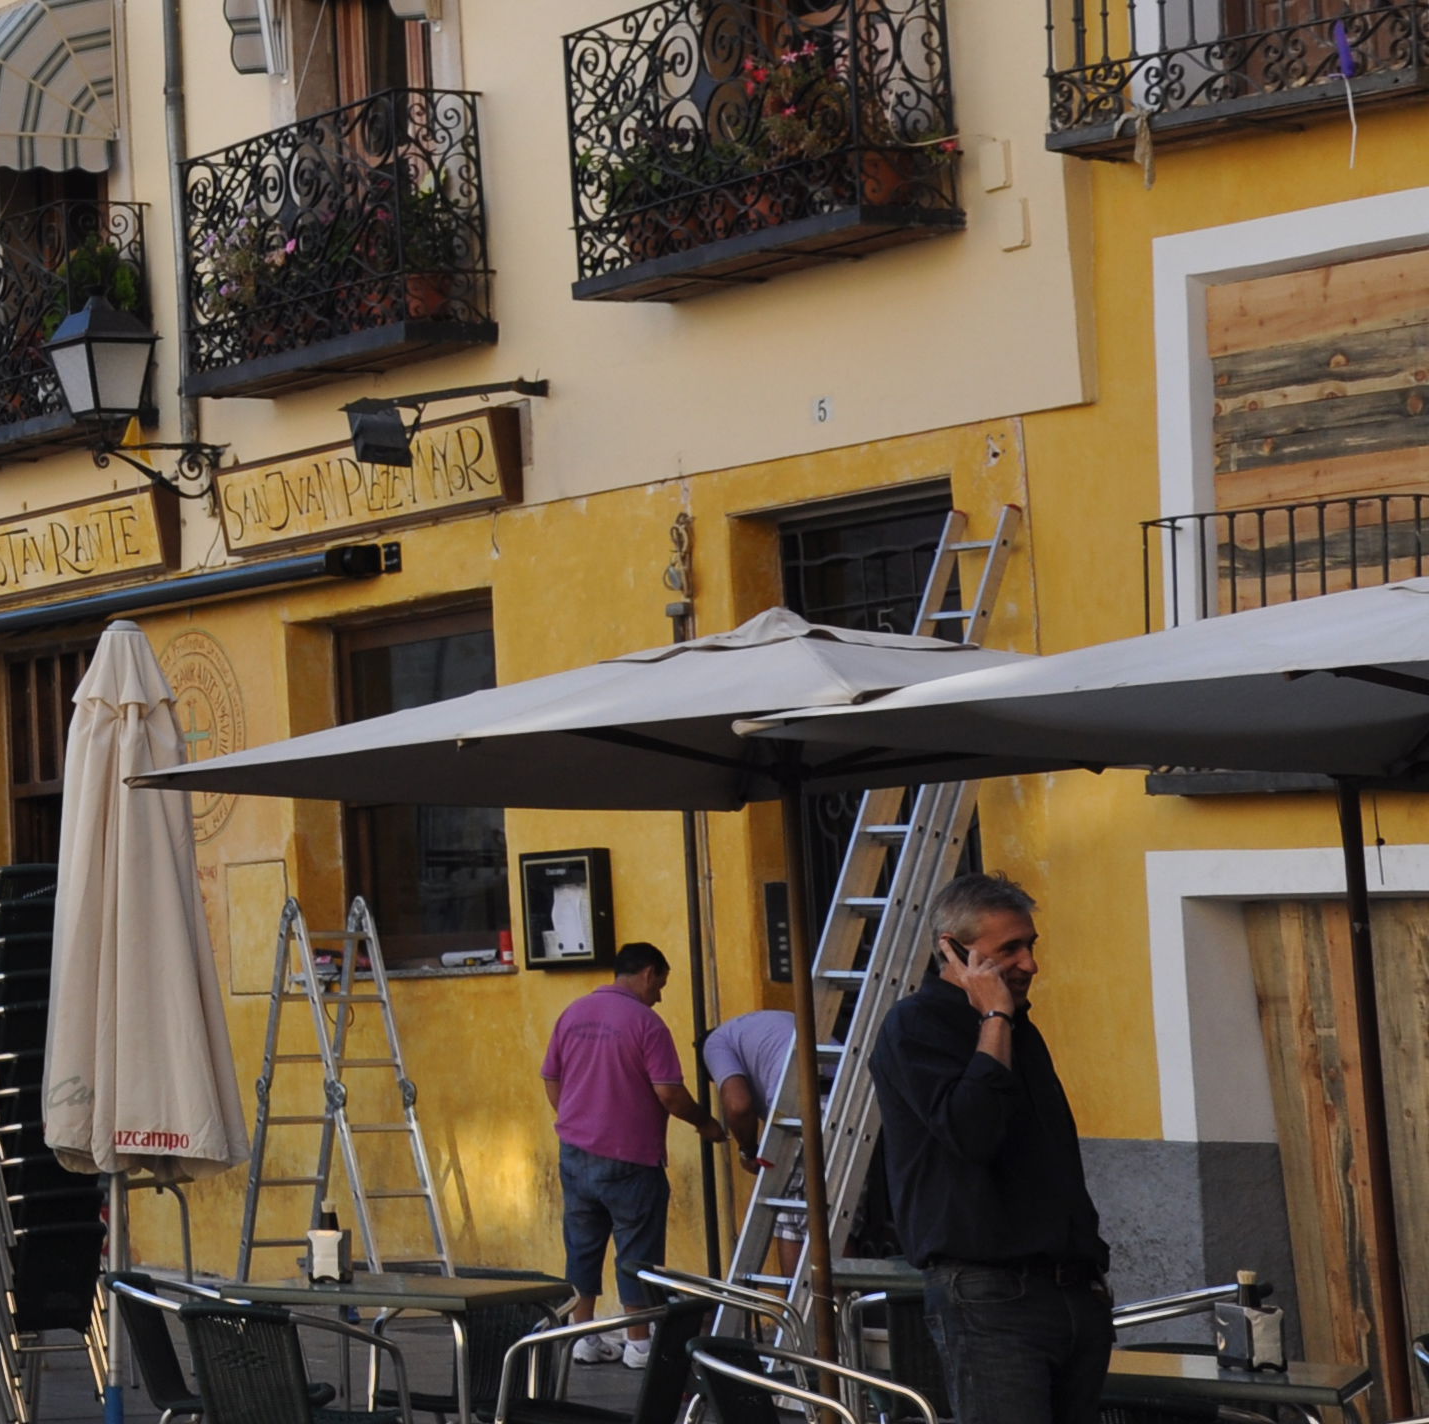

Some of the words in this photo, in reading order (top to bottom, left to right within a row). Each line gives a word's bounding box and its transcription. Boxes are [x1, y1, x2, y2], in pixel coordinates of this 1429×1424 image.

[818, 398, 827, 422] 5
[224, 483, 271, 541] SAN
[410, 426, 497, 504] MAYOR
[114, 1131, 189, 1150] uzcampo
